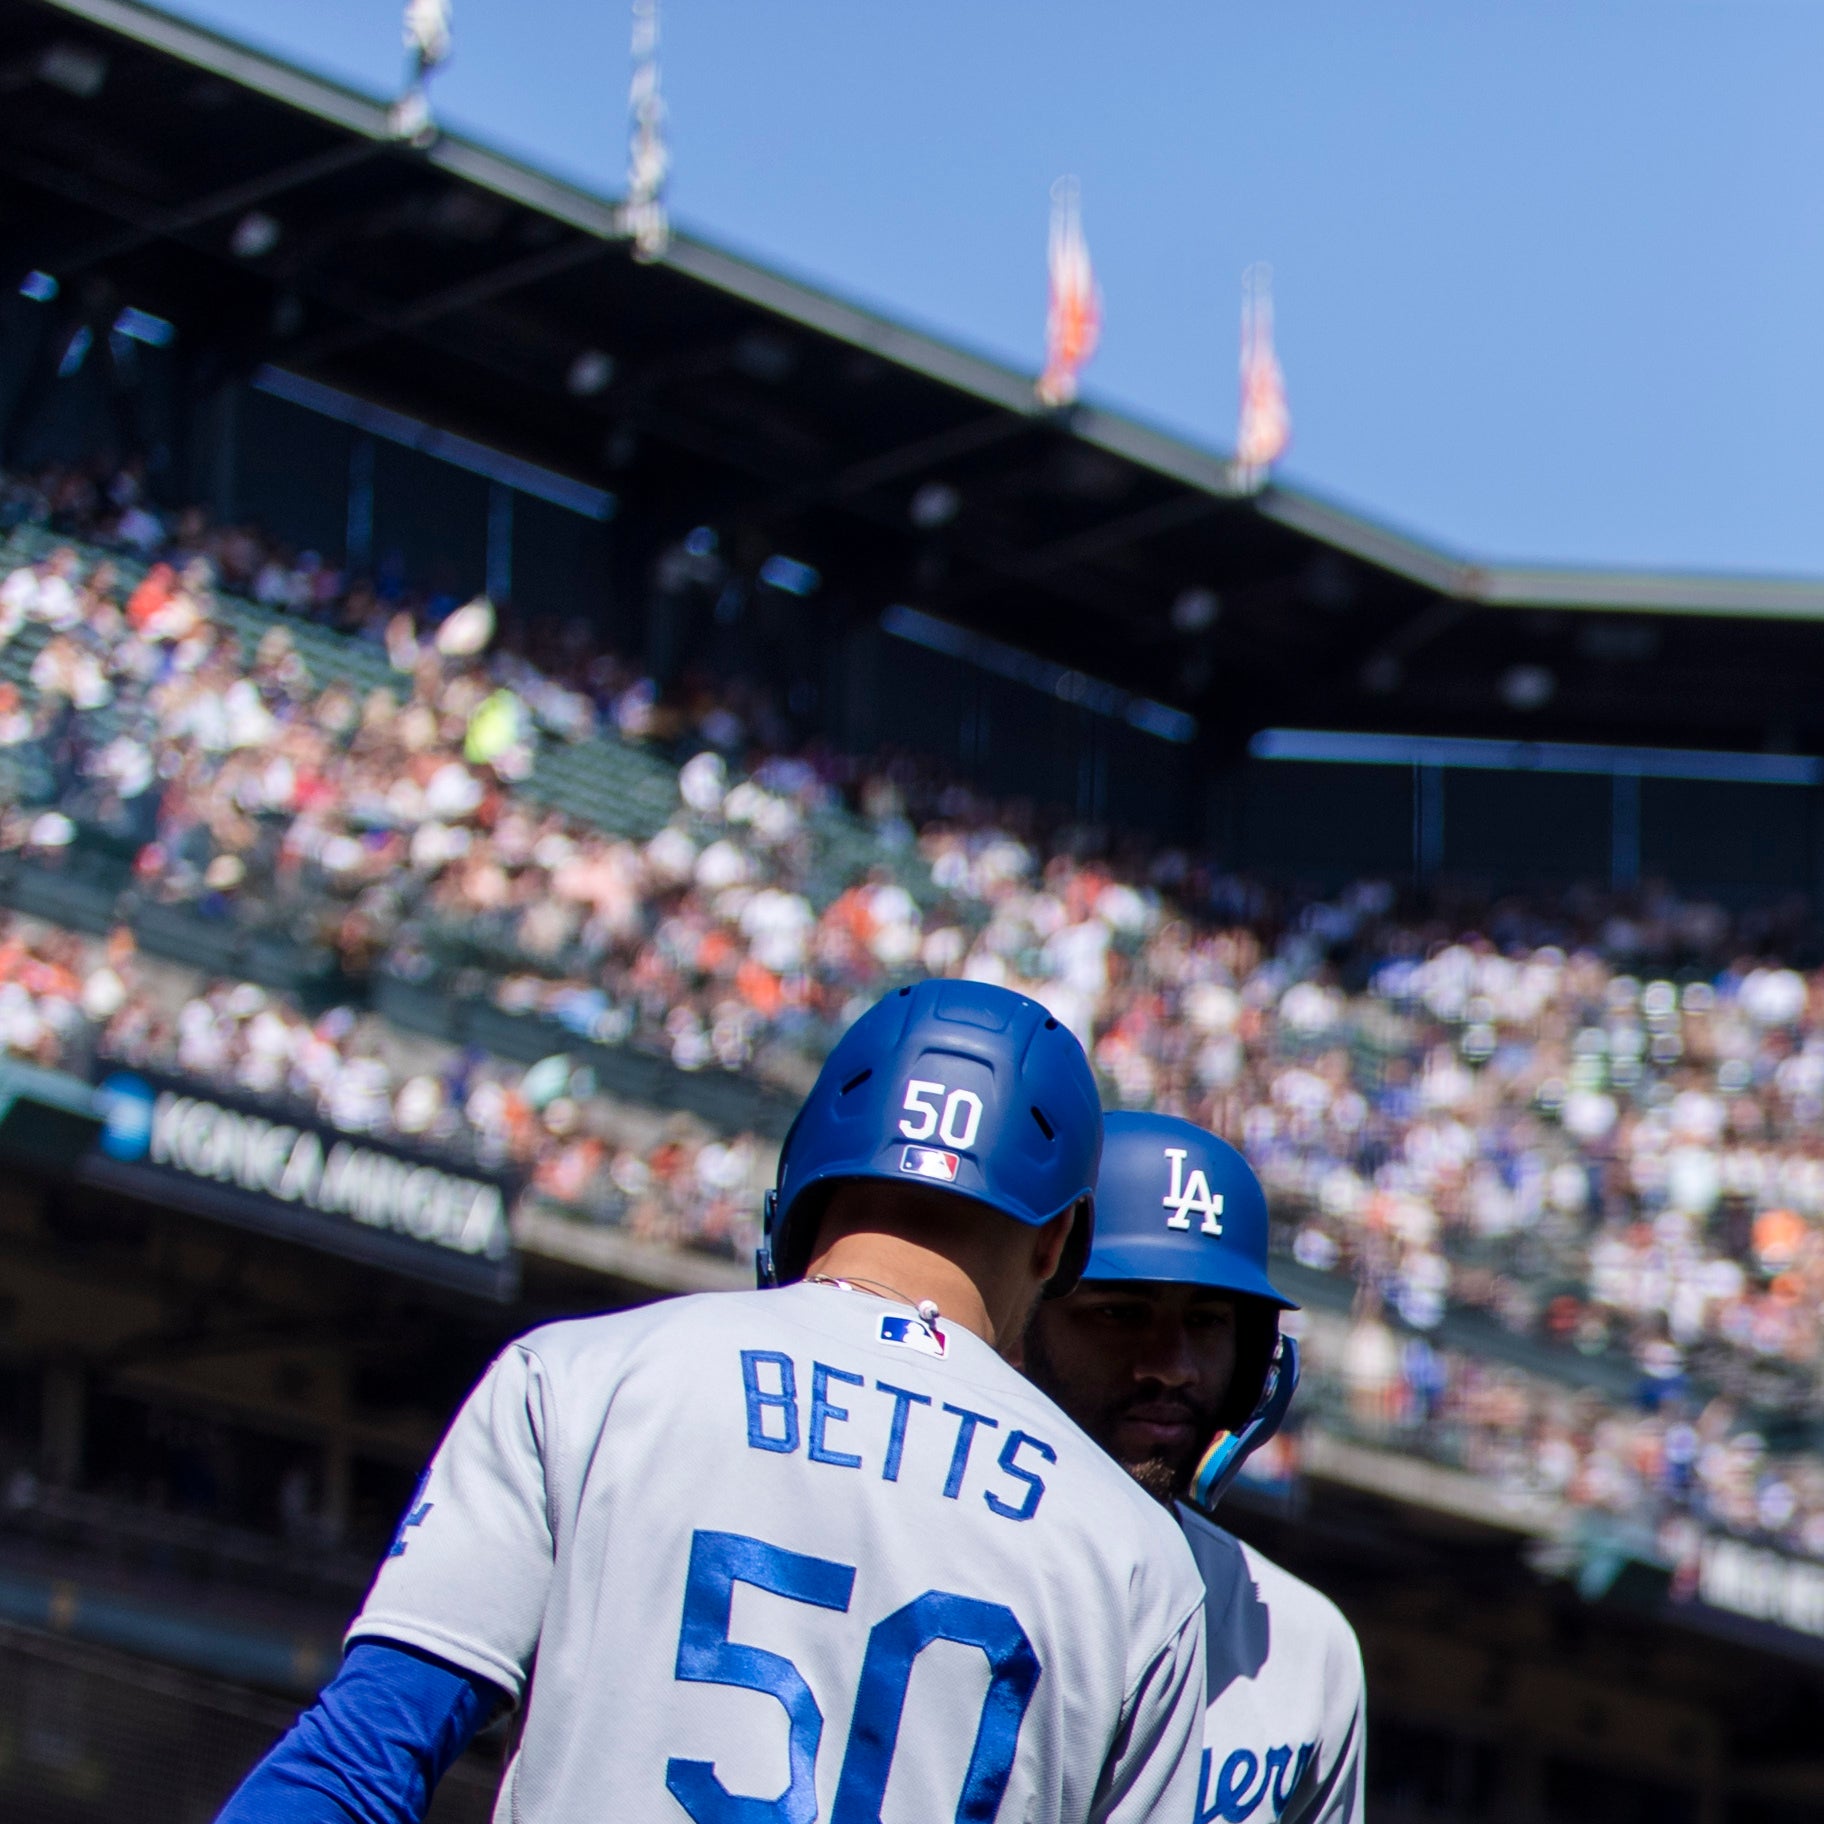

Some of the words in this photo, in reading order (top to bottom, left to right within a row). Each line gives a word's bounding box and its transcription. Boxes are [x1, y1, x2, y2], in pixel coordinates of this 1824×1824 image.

[899, 1079, 983, 1151] 50
[1162, 1148, 1224, 1237] LA
[739, 1349, 1057, 1522] BETTS
